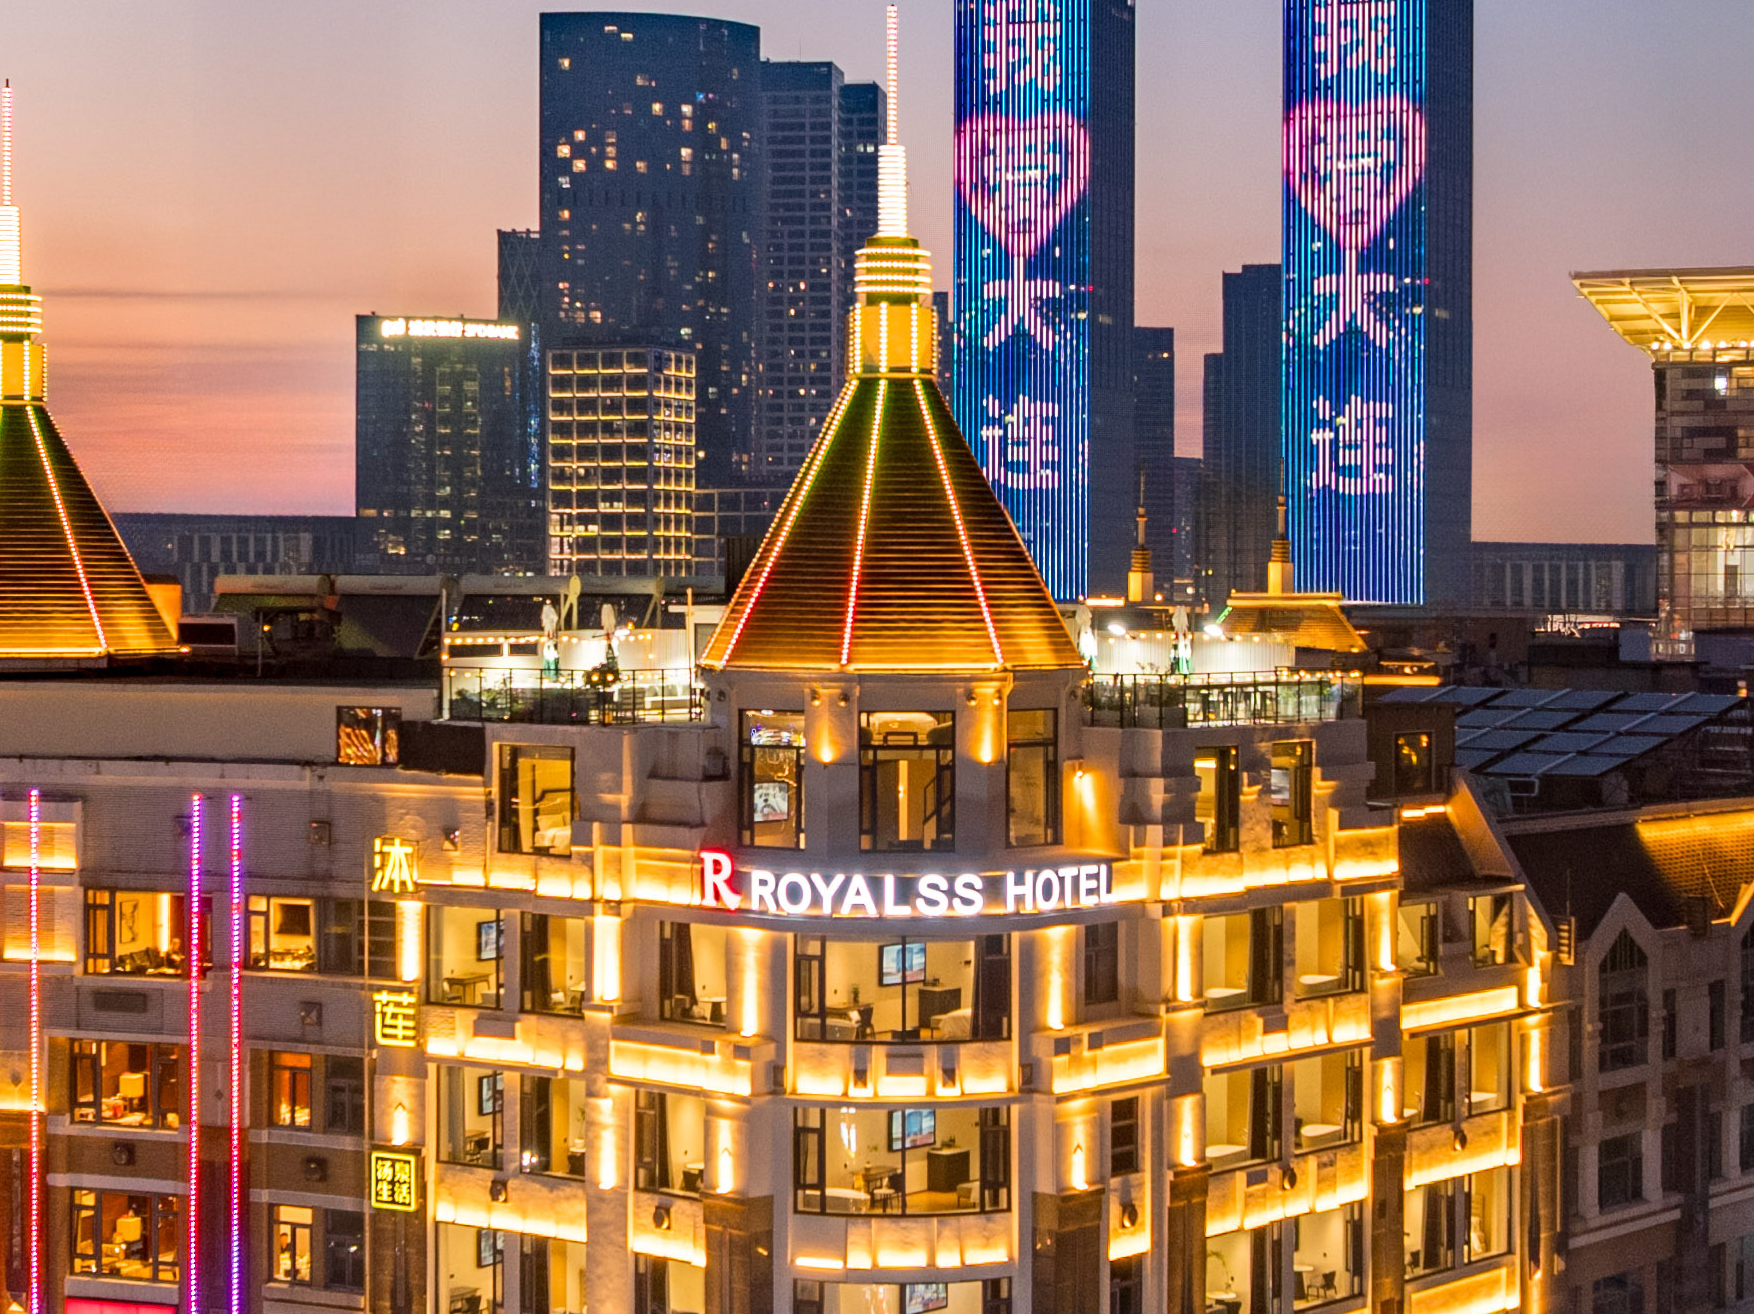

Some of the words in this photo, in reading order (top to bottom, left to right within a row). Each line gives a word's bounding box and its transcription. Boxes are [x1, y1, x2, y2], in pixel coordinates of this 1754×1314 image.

[699, 849, 743, 911] R
[750, 870, 985, 917] ROYALSS
[1005, 863, 1115, 913] HOTEL
[375, 1159, 412, 1183] 汤泉
[375, 1181, 412, 1205] 生活
